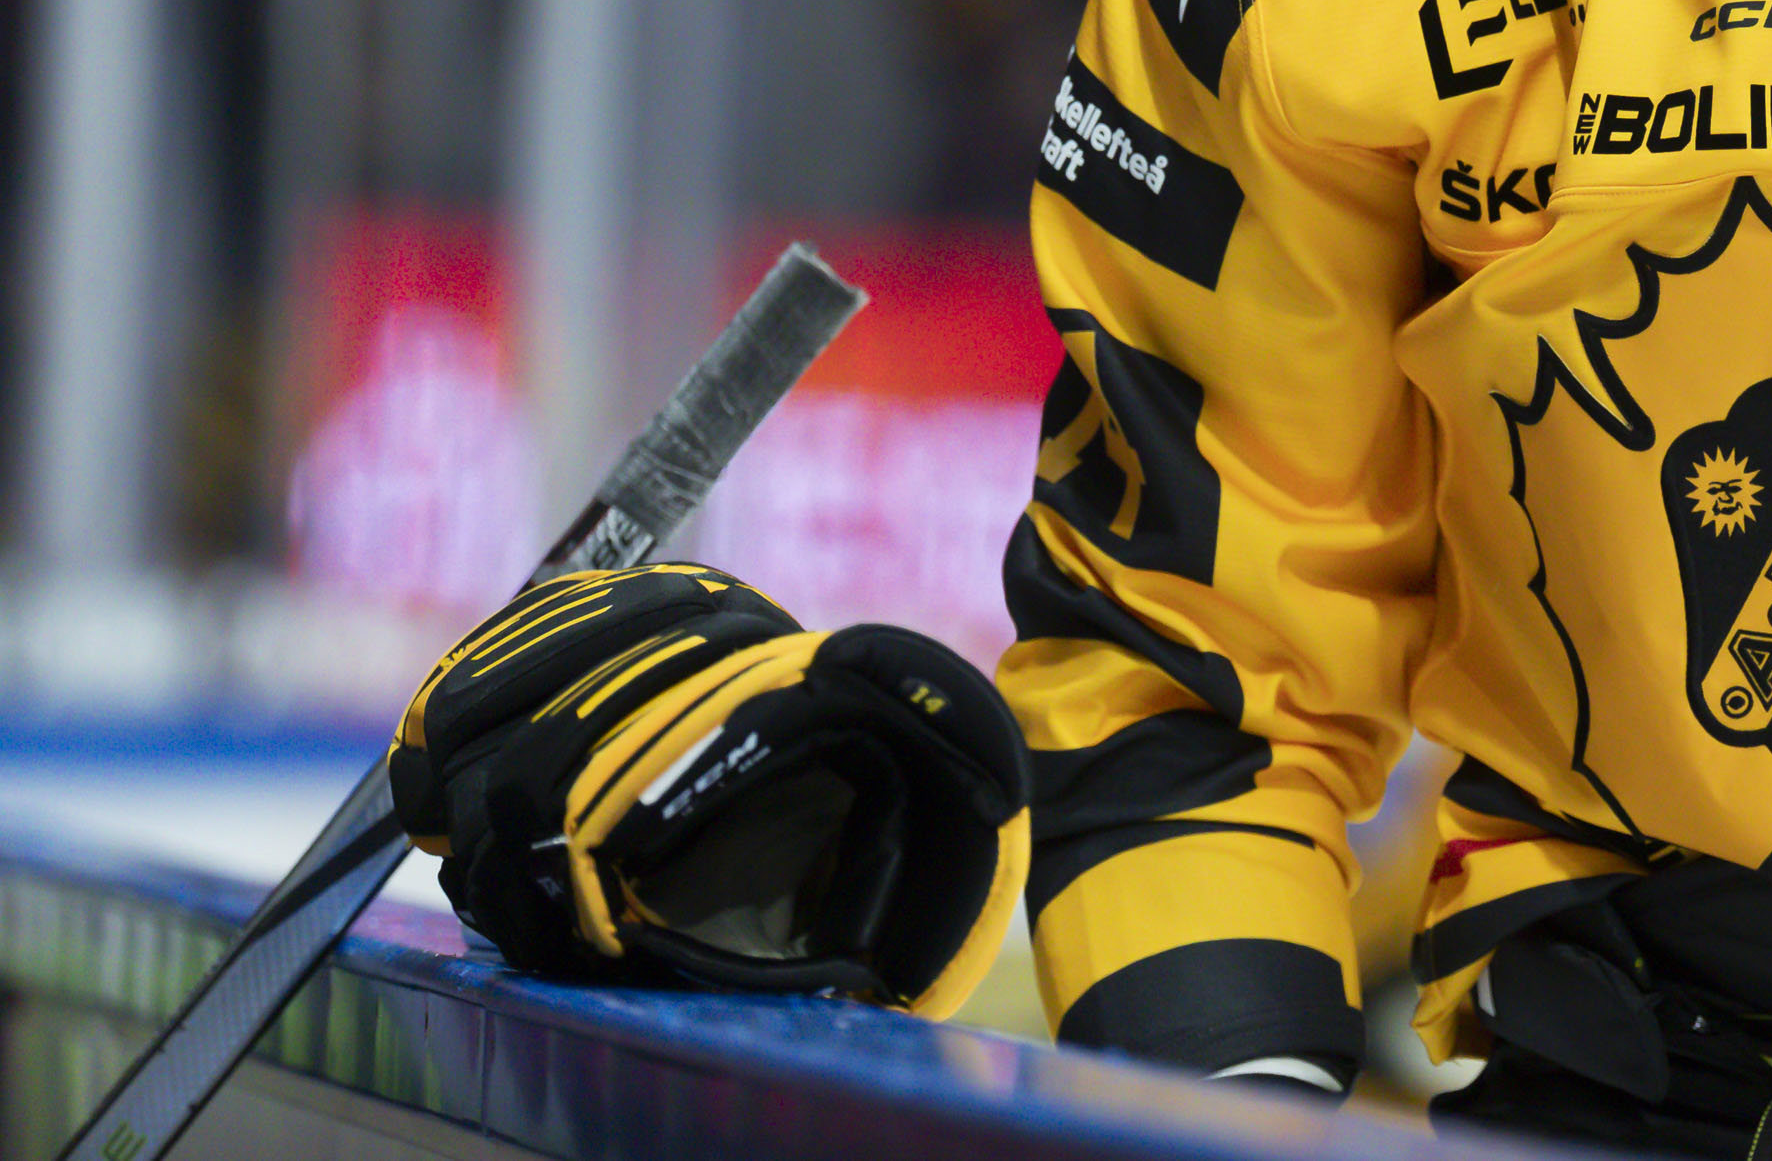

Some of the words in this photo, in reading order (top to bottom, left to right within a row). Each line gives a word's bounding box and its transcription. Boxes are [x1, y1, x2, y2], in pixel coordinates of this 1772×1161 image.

[1040, 115, 1085, 182] raft
[1054, 75, 1169, 196] kellefteå
[1572, 92, 1602, 156] NEW
